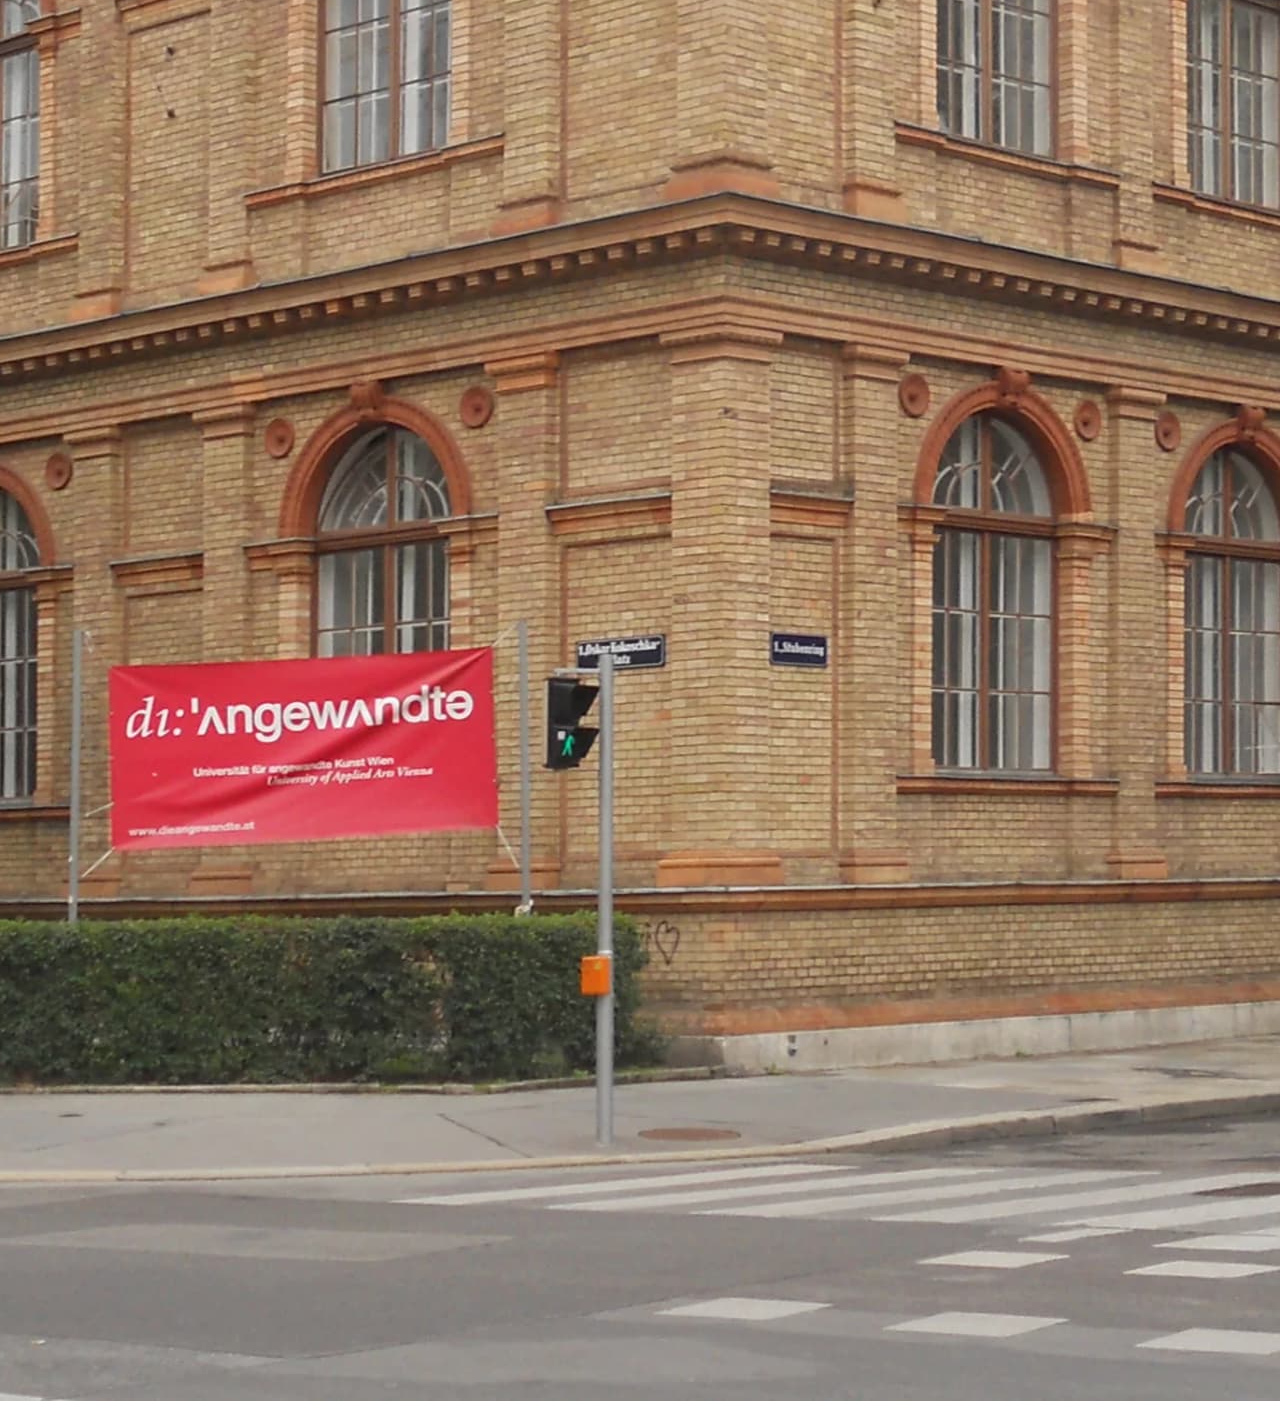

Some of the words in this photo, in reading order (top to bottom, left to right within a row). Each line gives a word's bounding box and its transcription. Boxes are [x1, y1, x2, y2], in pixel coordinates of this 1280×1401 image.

[192, 765, 250, 778] Universität
[251, 764, 267, 775] für
[269, 761, 332, 776] angewandte
[334, 758, 366, 769] Kunst
[367, 756, 395, 766] Wien
[267, 773, 318, 786] University
[319, 771, 332, 785] of
[332, 768, 372, 785] Applied
[373, 767, 395, 779] Arts
[397, 766, 434, 777] Vienna
